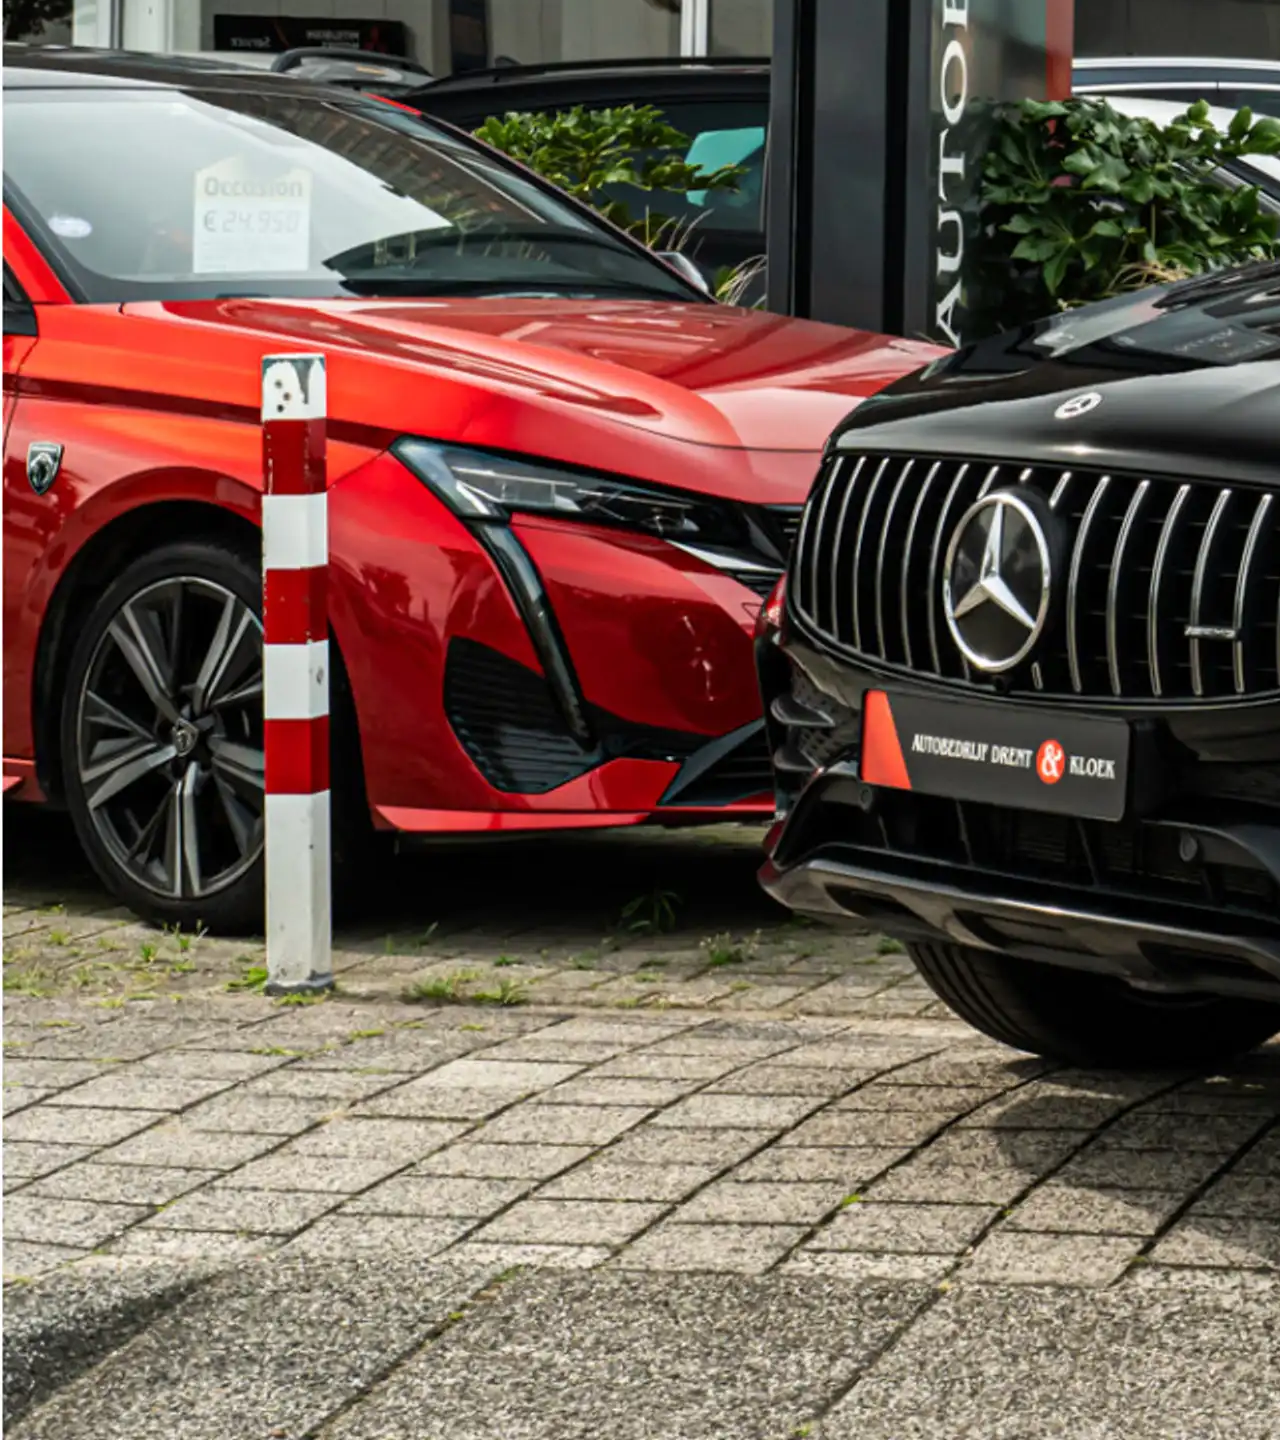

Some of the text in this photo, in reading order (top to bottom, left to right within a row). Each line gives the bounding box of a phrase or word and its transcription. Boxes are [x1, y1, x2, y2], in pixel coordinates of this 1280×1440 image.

[203, 176, 304, 197] Occasion
[911, 732, 1116, 780] AUTOBEDRIJF DRENT & KLOEK
